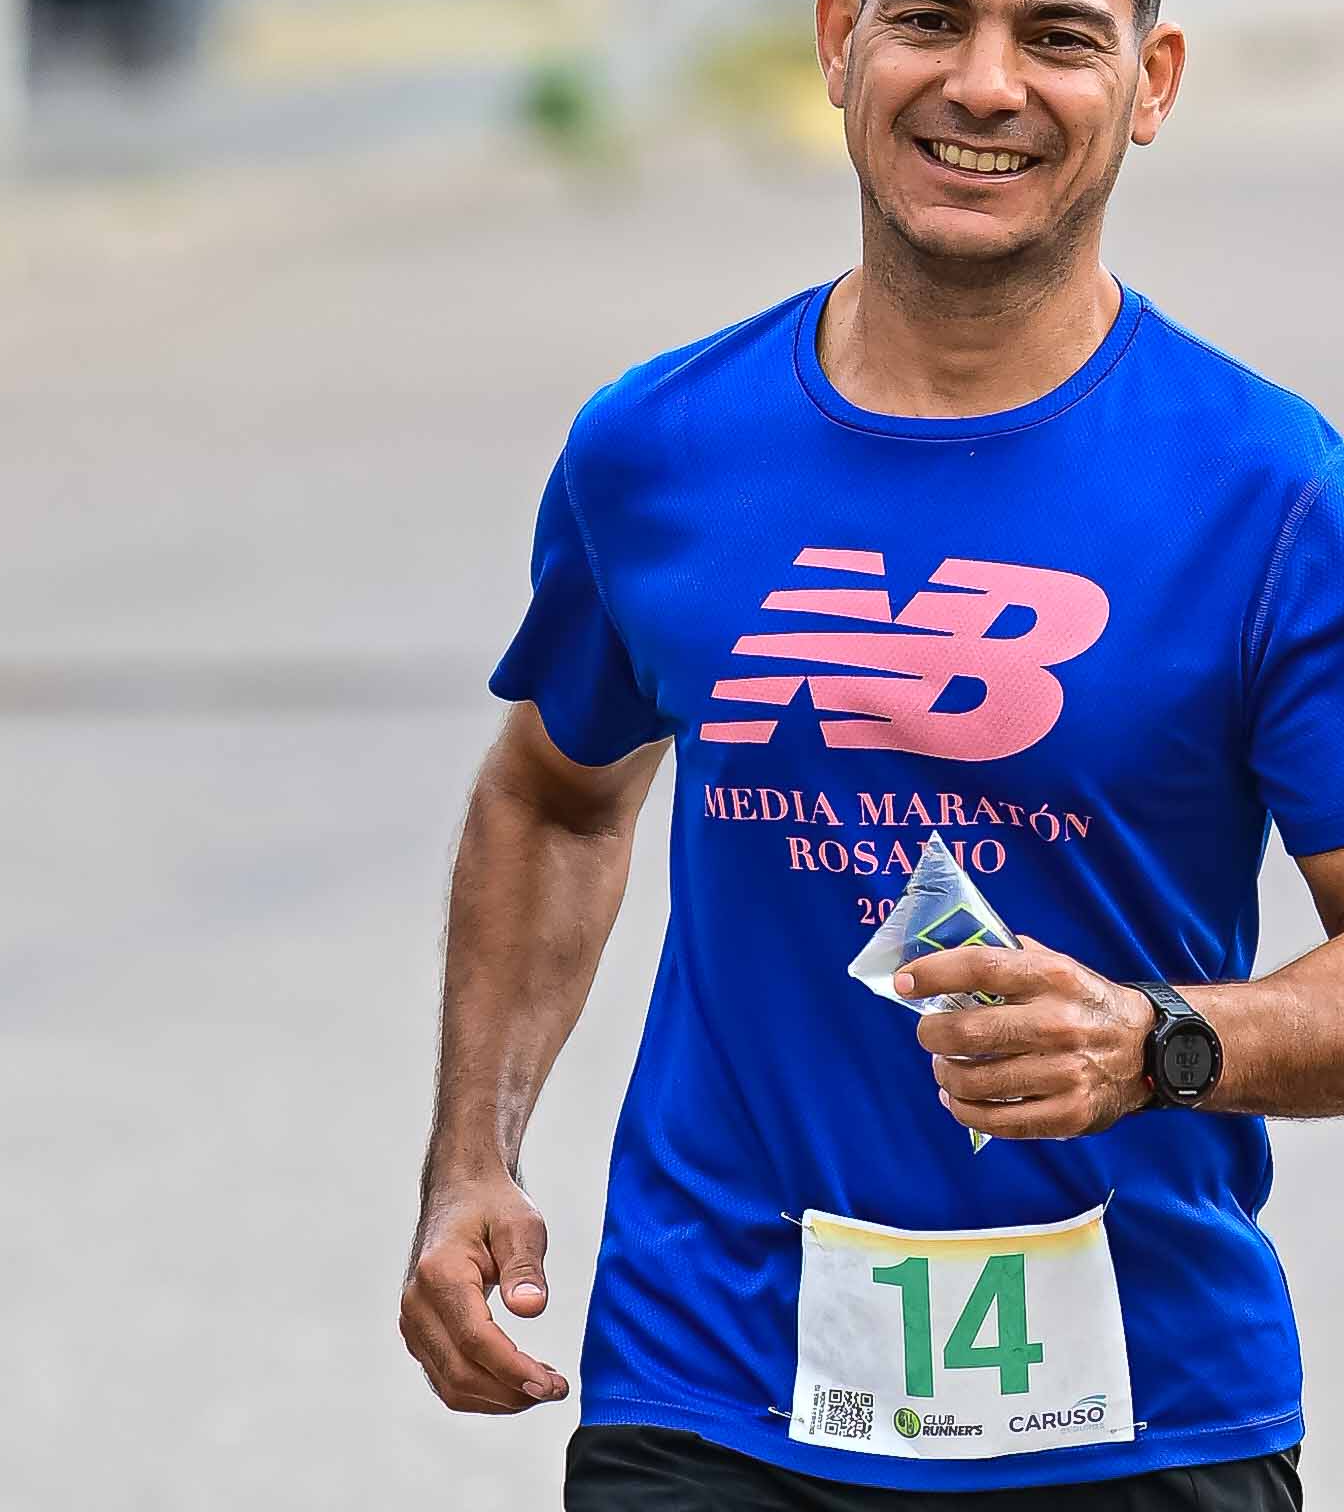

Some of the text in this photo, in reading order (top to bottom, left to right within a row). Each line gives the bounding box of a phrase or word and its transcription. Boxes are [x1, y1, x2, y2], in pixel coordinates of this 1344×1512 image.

[700, 548, 1111, 762] NB
[704, 785, 1094, 843] MEDIA MARATÓN
[857, 897, 896, 926] 20
[872, 1253, 1044, 1398] 14
[922, 1424, 983, 1437] RUNNER'S
[923, 1414, 955, 1426] CLUB
[1008, 1406, 1104, 1433] CARUSO
